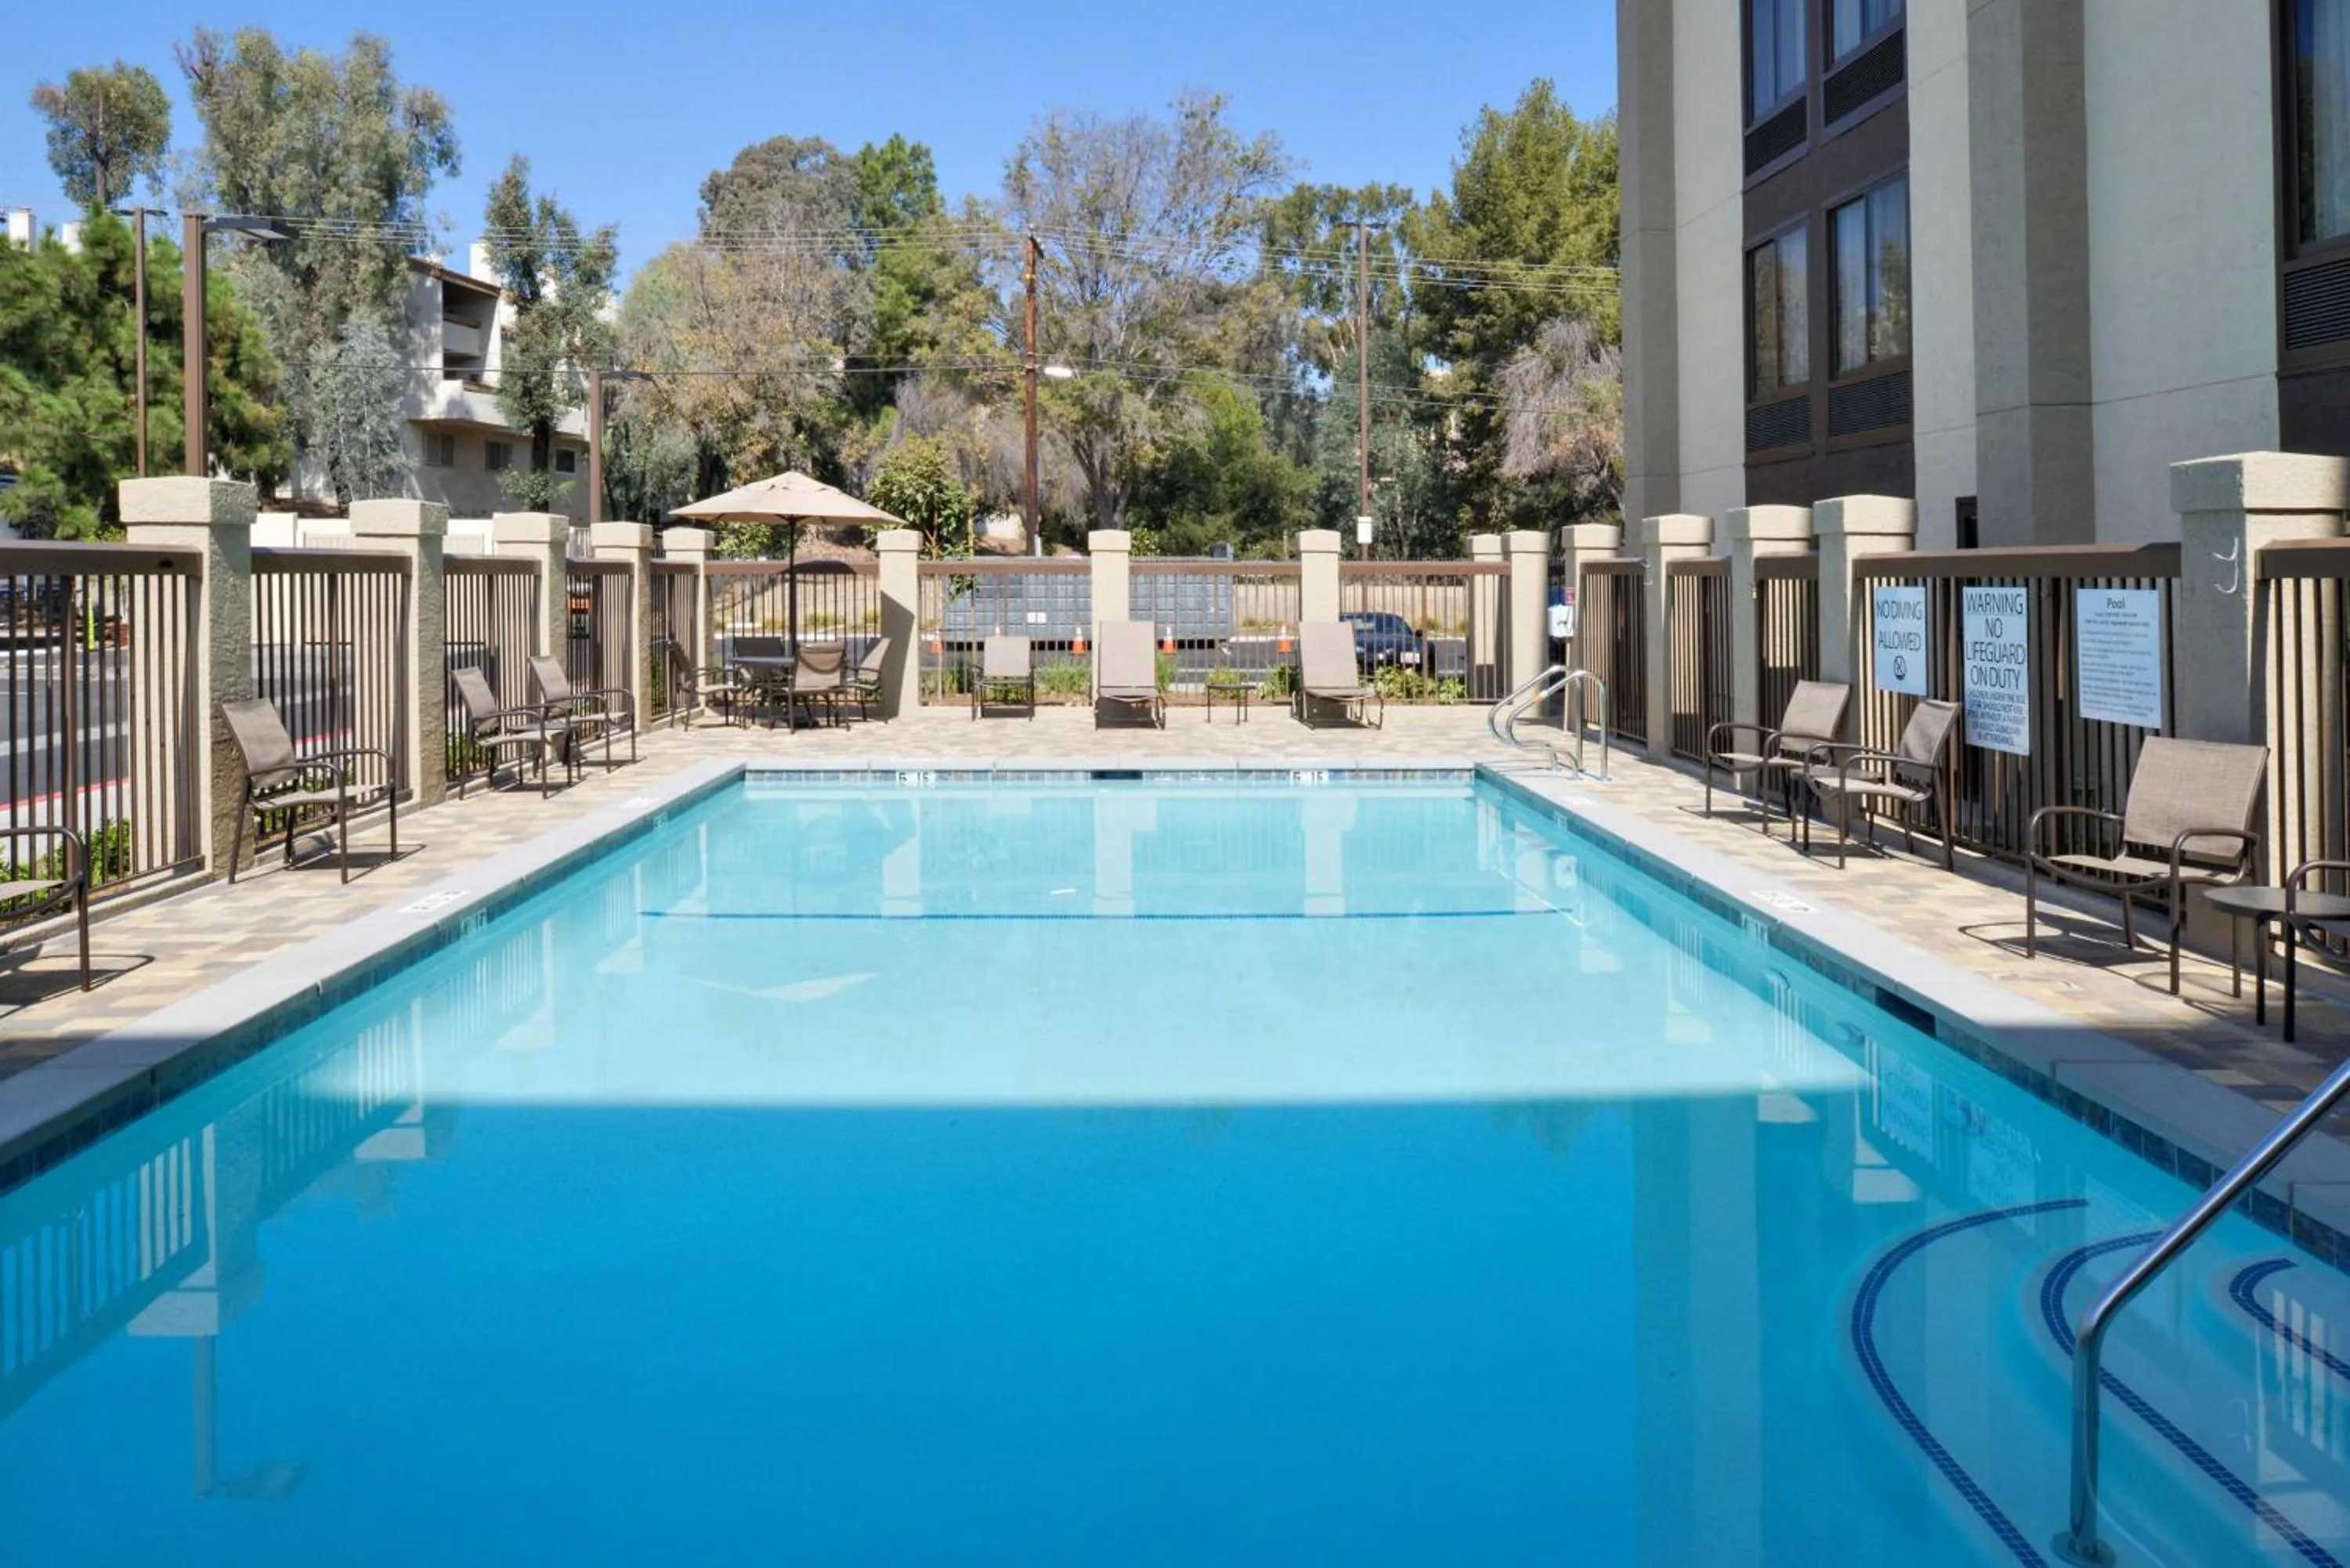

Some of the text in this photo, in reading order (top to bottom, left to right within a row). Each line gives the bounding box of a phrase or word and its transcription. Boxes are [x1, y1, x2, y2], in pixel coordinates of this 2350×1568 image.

[1876, 600, 1890, 620] NO
[1965, 593, 2023, 615] WARNING
[2106, 595, 2125, 609] Pool
[1985, 617, 2003, 638] NO
[1878, 630, 1922, 651] ALLOWED
[1965, 641, 2026, 665] LIFEGUARD
[1970, 665, 2021, 690] ON DUTY
